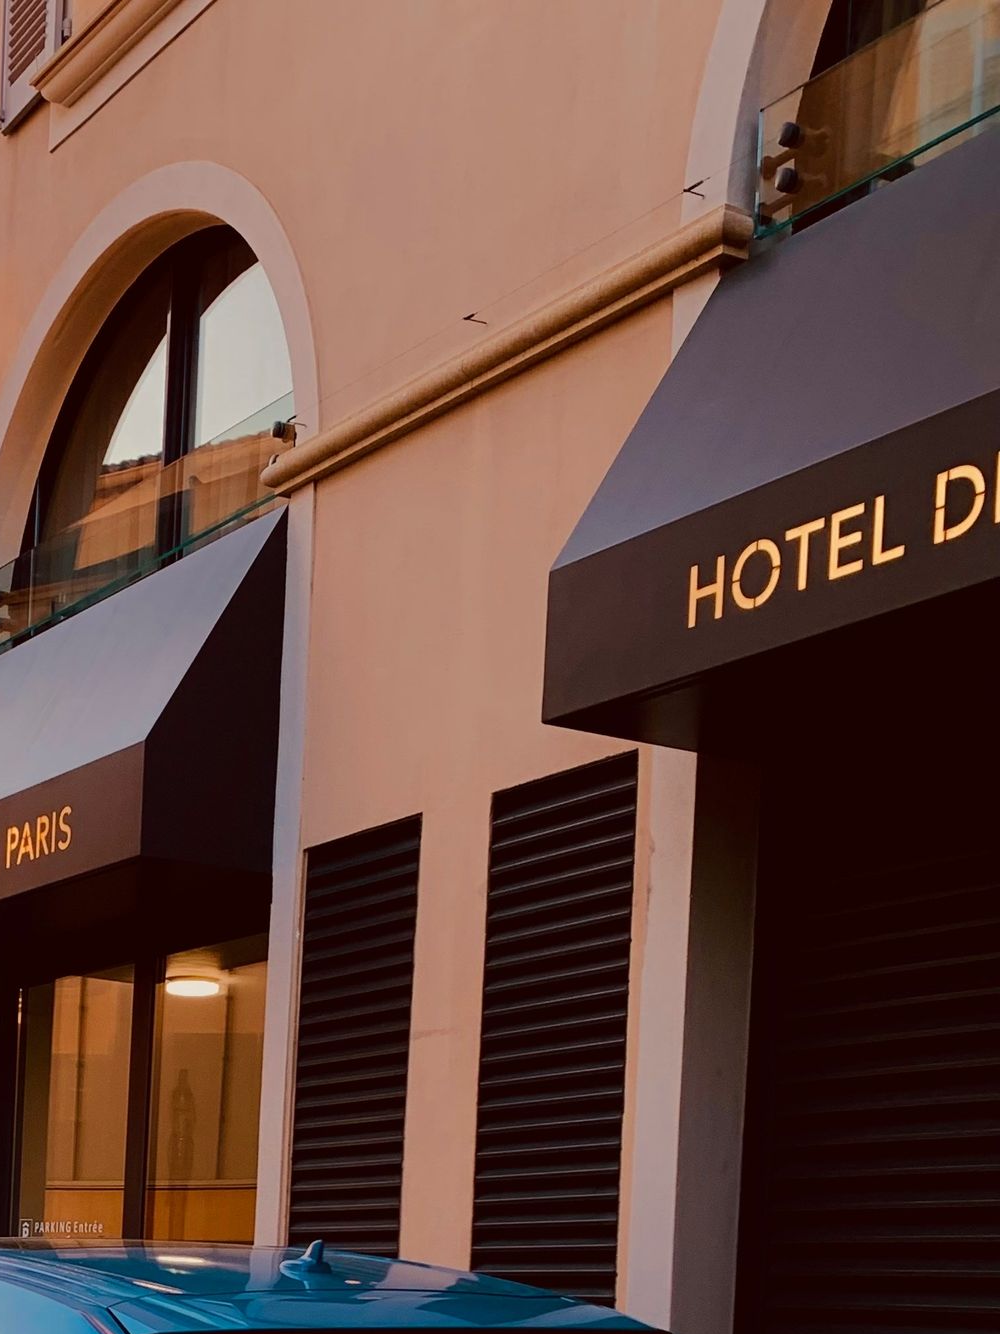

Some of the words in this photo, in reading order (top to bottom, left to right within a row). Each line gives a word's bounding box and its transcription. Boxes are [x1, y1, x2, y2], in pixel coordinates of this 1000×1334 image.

[687, 495, 906, 629] HOTEL
[6, 805, 73, 869] PARIS
[34, 1221, 72, 1233] PARKING
[73, 1220, 104, 1233] Entrée
